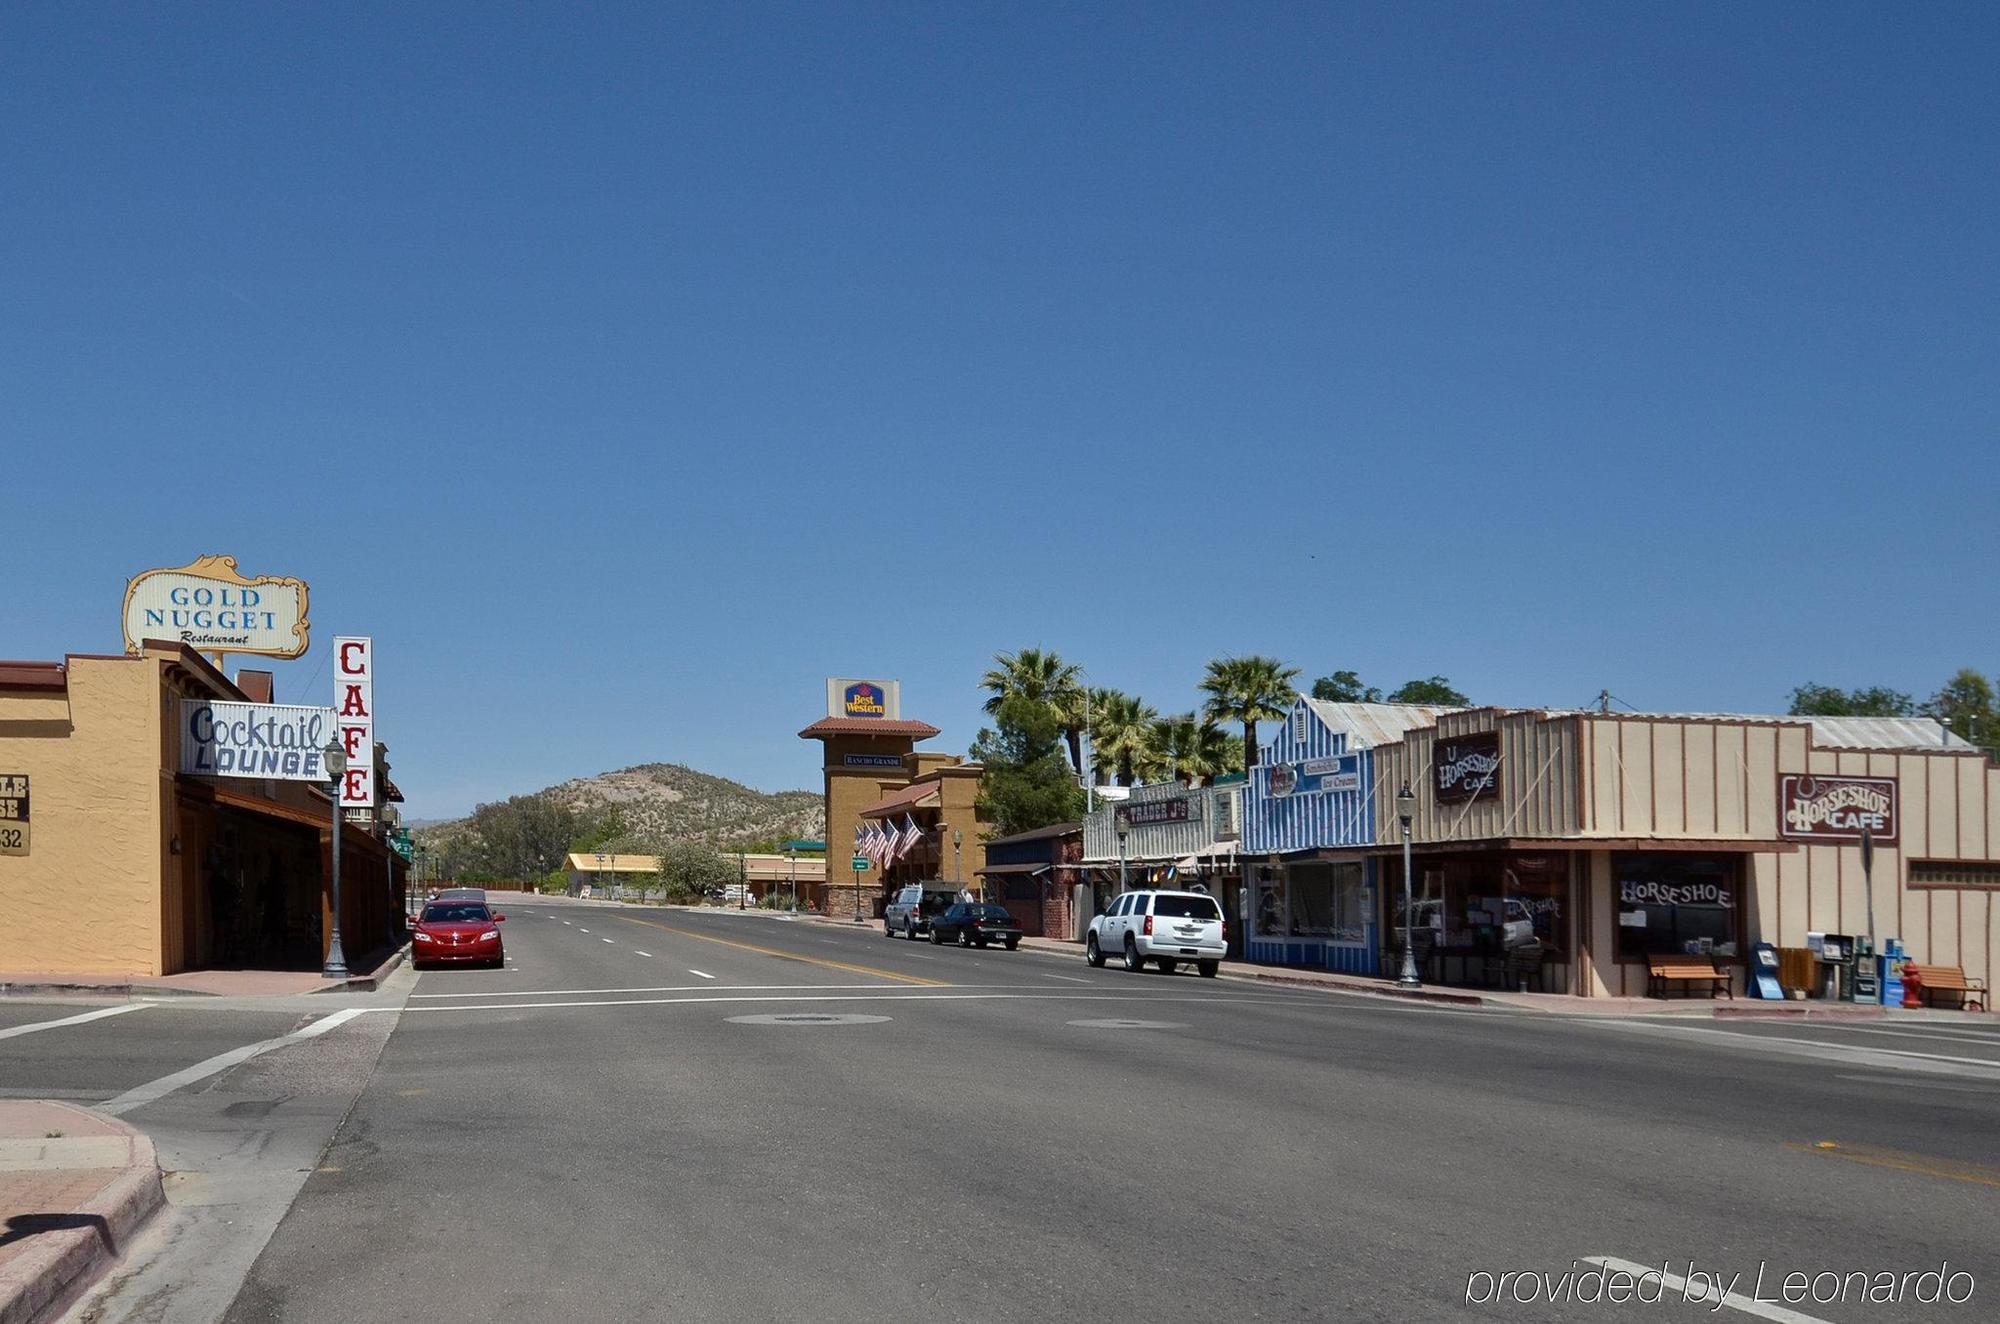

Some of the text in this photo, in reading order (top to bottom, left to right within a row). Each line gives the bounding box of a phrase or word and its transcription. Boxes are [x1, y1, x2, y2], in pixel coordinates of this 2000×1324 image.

[171, 587, 260, 607] GOLD
[144, 609, 275, 630] NUGGET
[180, 630, 249, 645] Restaurant
[846, 702, 883, 713] Western
[853, 694, 874, 705] Best
[190, 706, 326, 750] Cocktail
[339, 642, 369, 801] CAFE
[195, 746, 320, 775] LOUNGE
[1439, 751, 1498, 789] HORSESHOE
[1463, 776, 1494, 790] CAFE
[1130, 803, 1168, 822] TRADER
[1787, 785, 1890, 831] HORSESHOE
[1831, 812, 1884, 829] CAFE
[0, 829, 22, 848] 32
[1621, 880, 1732, 908] HORSESHOE
